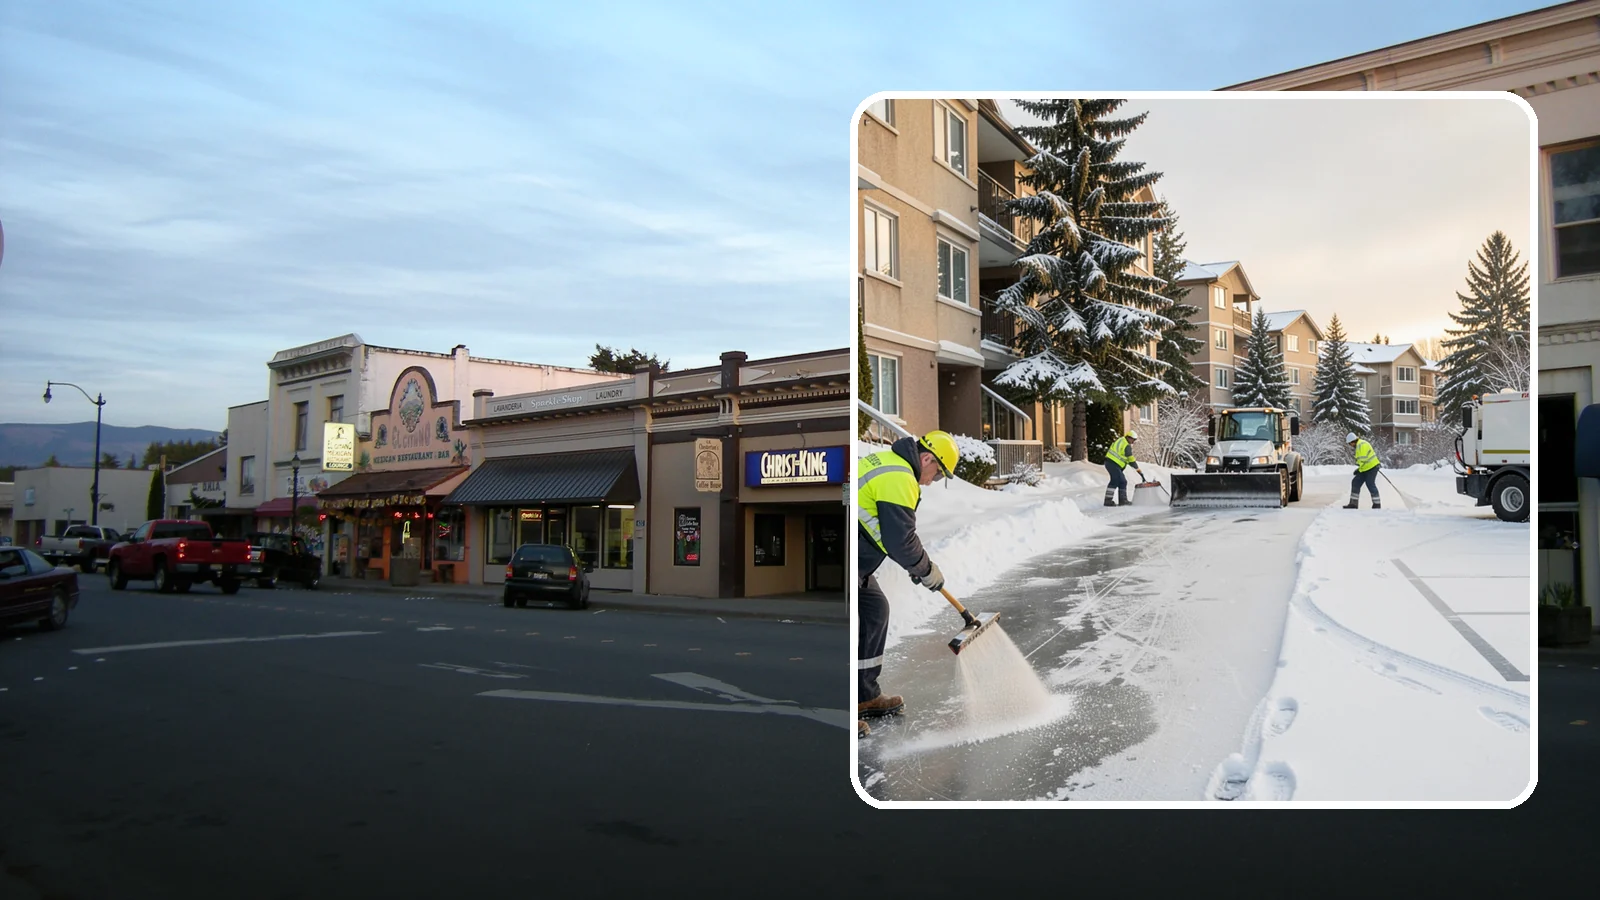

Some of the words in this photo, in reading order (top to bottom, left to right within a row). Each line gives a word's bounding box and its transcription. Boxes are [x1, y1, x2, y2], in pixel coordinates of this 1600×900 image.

[562, 394, 582, 405] Shop
[595, 389, 623, 400] LAUNDRY
[493, 402, 522, 413] LAVANDERIA
[373, 454, 396, 464] MEXICAN
[398, 451, 433, 462] RESTAURANT
[438, 450, 450, 459] BAR
[761, 452, 797, 478] CHRIST
[799, 450, 827, 476] KING
